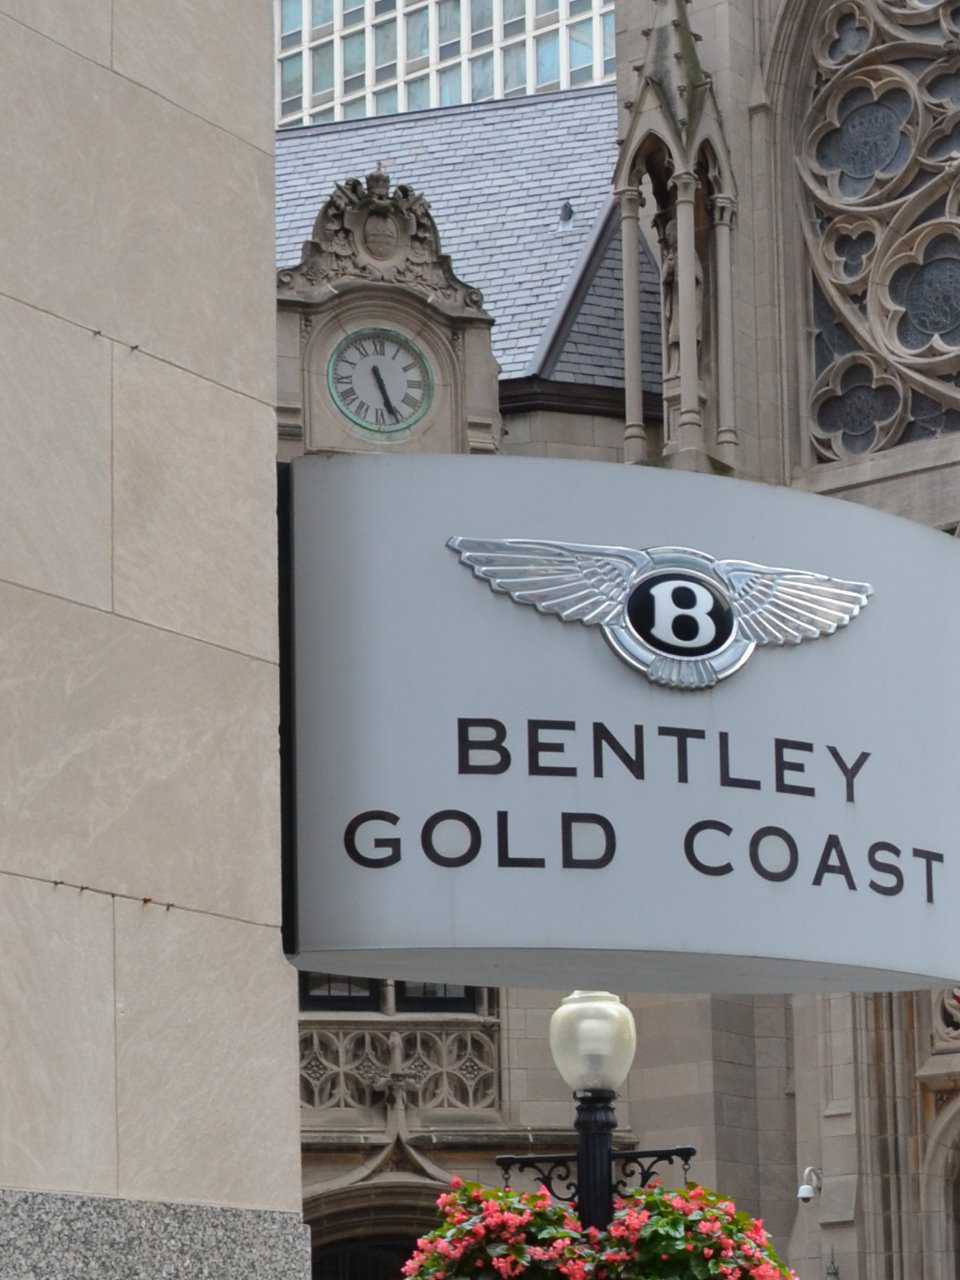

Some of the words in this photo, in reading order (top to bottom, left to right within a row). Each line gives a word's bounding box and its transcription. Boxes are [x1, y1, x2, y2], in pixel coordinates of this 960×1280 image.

[650, 579, 717, 649] B
[456, 716, 872, 804] BENTLEY
[343, 809, 616, 870] GOLD
[683, 819, 944, 904] COAST
